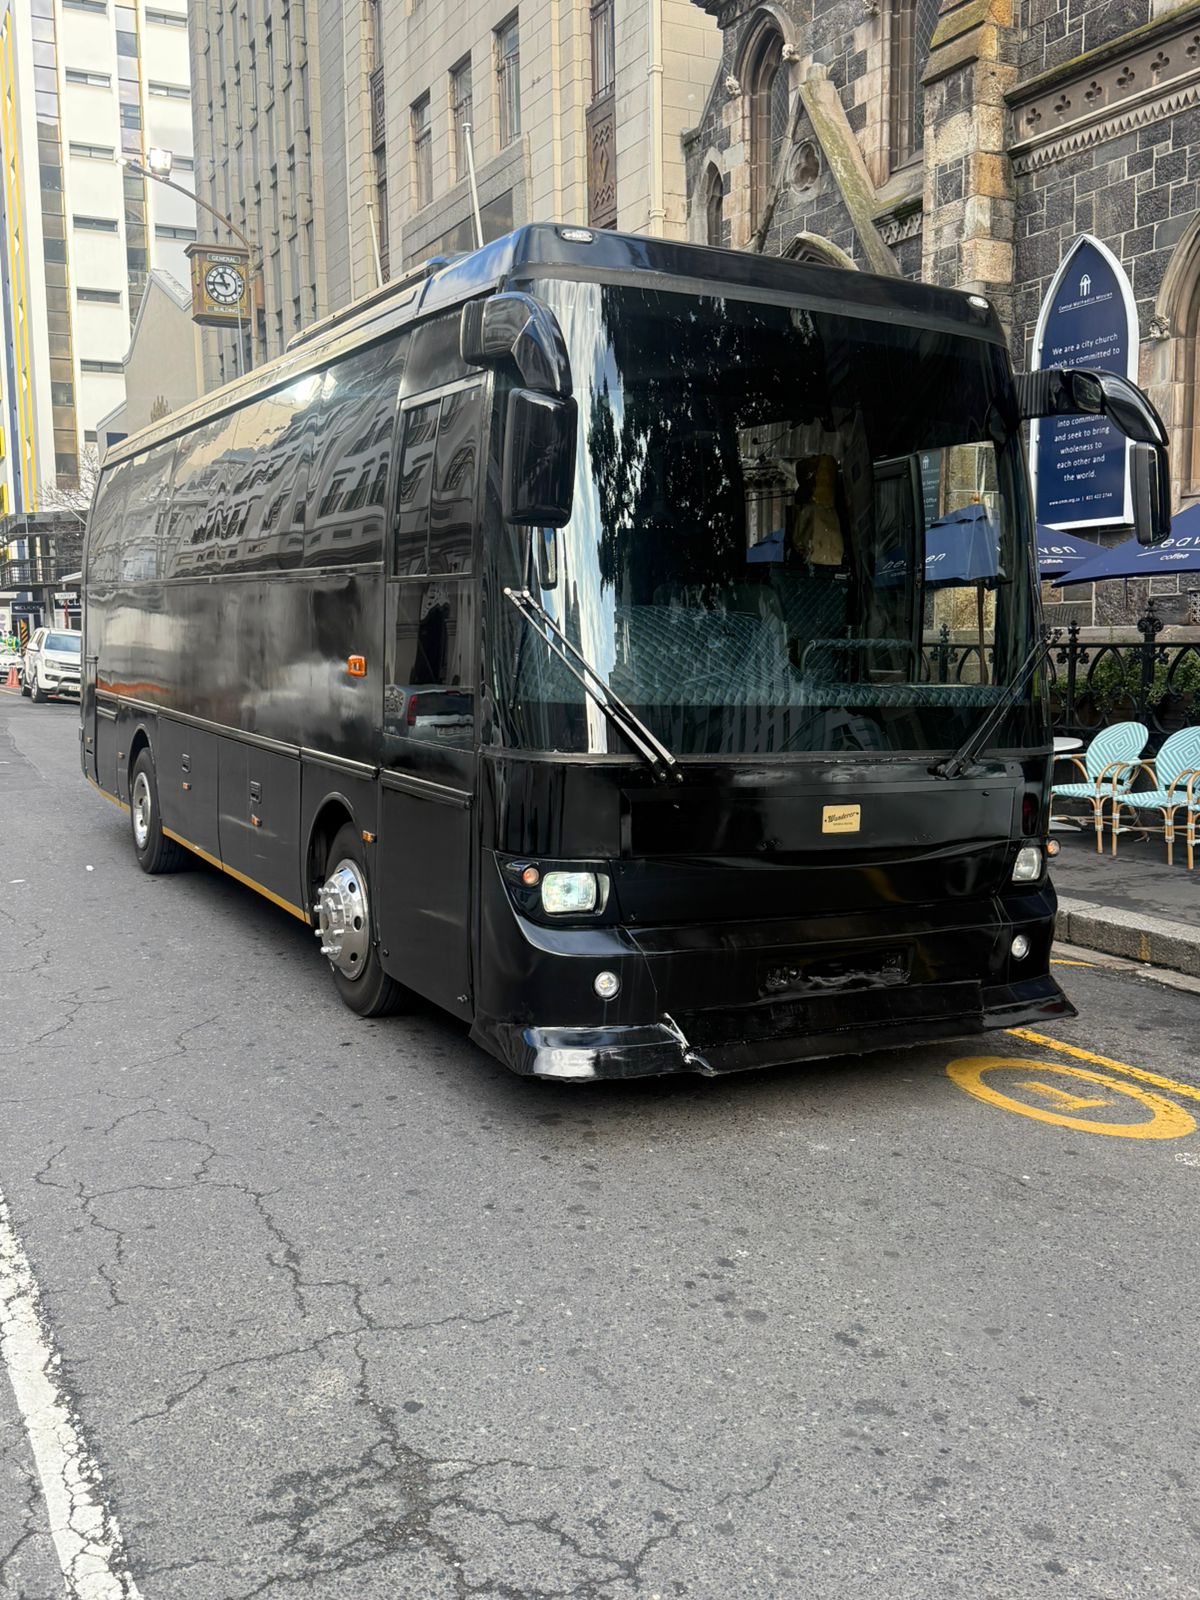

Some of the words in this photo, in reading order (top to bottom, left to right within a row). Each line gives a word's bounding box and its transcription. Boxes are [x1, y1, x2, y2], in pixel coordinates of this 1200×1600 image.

[1052, 347, 1063, 355] We
[1064, 345, 1075, 353] are
[1081, 340, 1093, 348] city
[1095, 333, 1118, 345] church
[1076, 348, 1111, 364] committed
[1112, 347, 1120, 355] to
[1057, 419, 1070, 428] into
[1054, 433, 1067, 442] and
[1067, 430, 1082, 440] seek
[1092, 426, 1110, 435] bring
[1060, 443, 1094, 454] wholeness
[1095, 441, 1103, 449] to
[1056, 461, 1072, 469] each
[1073, 457, 1091, 467] other
[1092, 454, 1105, 463] and
[1063, 473, 1075, 481] the
[1076, 470, 1096, 479] world.
[1037, 545, 1078, 555] ven
[1160, 552, 1190, 561] coffee
